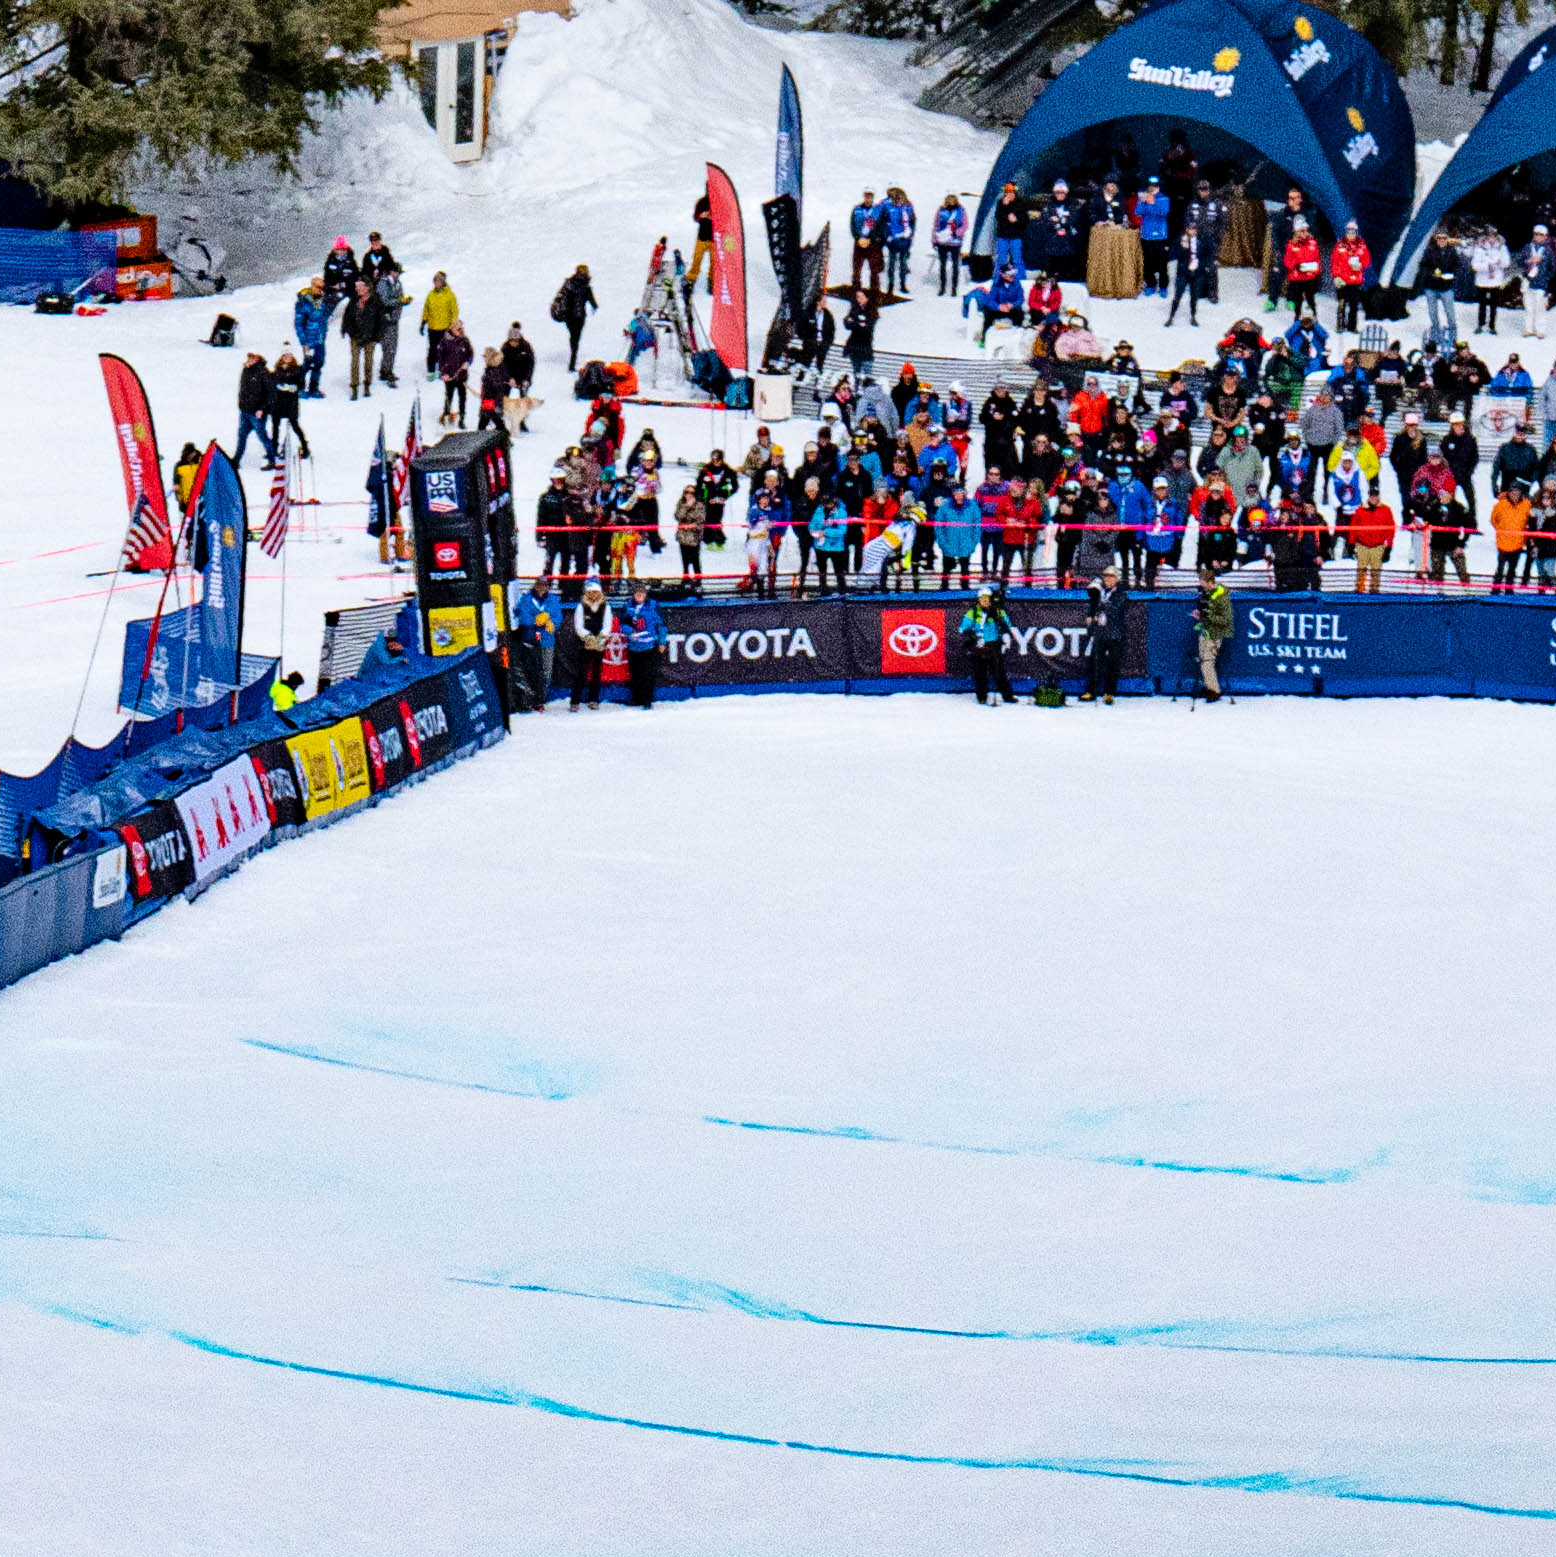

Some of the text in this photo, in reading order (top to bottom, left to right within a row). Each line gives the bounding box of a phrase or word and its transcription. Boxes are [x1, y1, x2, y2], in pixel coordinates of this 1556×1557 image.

[1247, 607, 1348, 642] STIFEL
[667, 627, 816, 664] TOYOTA
[1001, 626, 1095, 657] YOT
[1248, 644, 1347, 660] U.S. SKI TEAM
